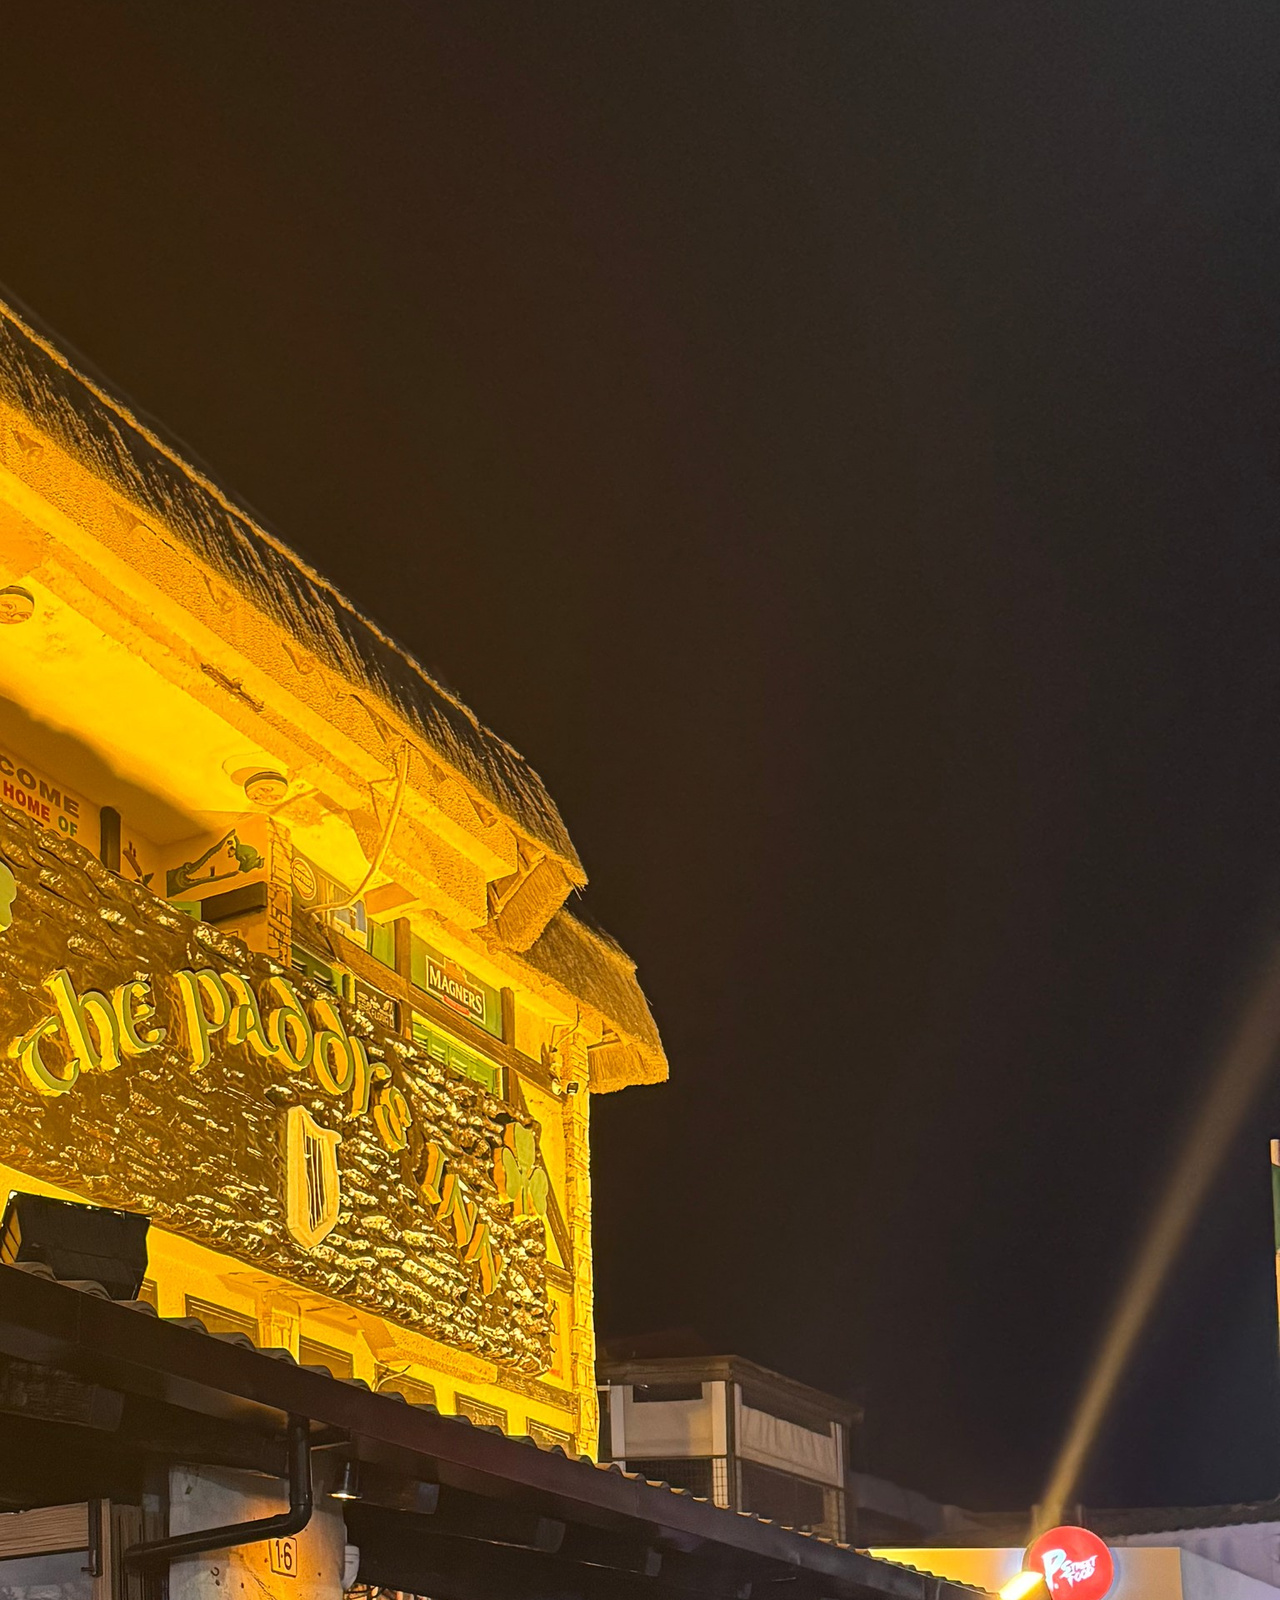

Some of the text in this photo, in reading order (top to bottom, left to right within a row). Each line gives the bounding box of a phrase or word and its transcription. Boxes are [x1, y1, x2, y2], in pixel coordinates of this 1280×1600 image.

[2, 780, 52, 824] HOME
[56, 814, 80, 837] OF
[428, 966, 484, 1016] MAGNERS
[1060, 1554, 1099, 1574] STREET
